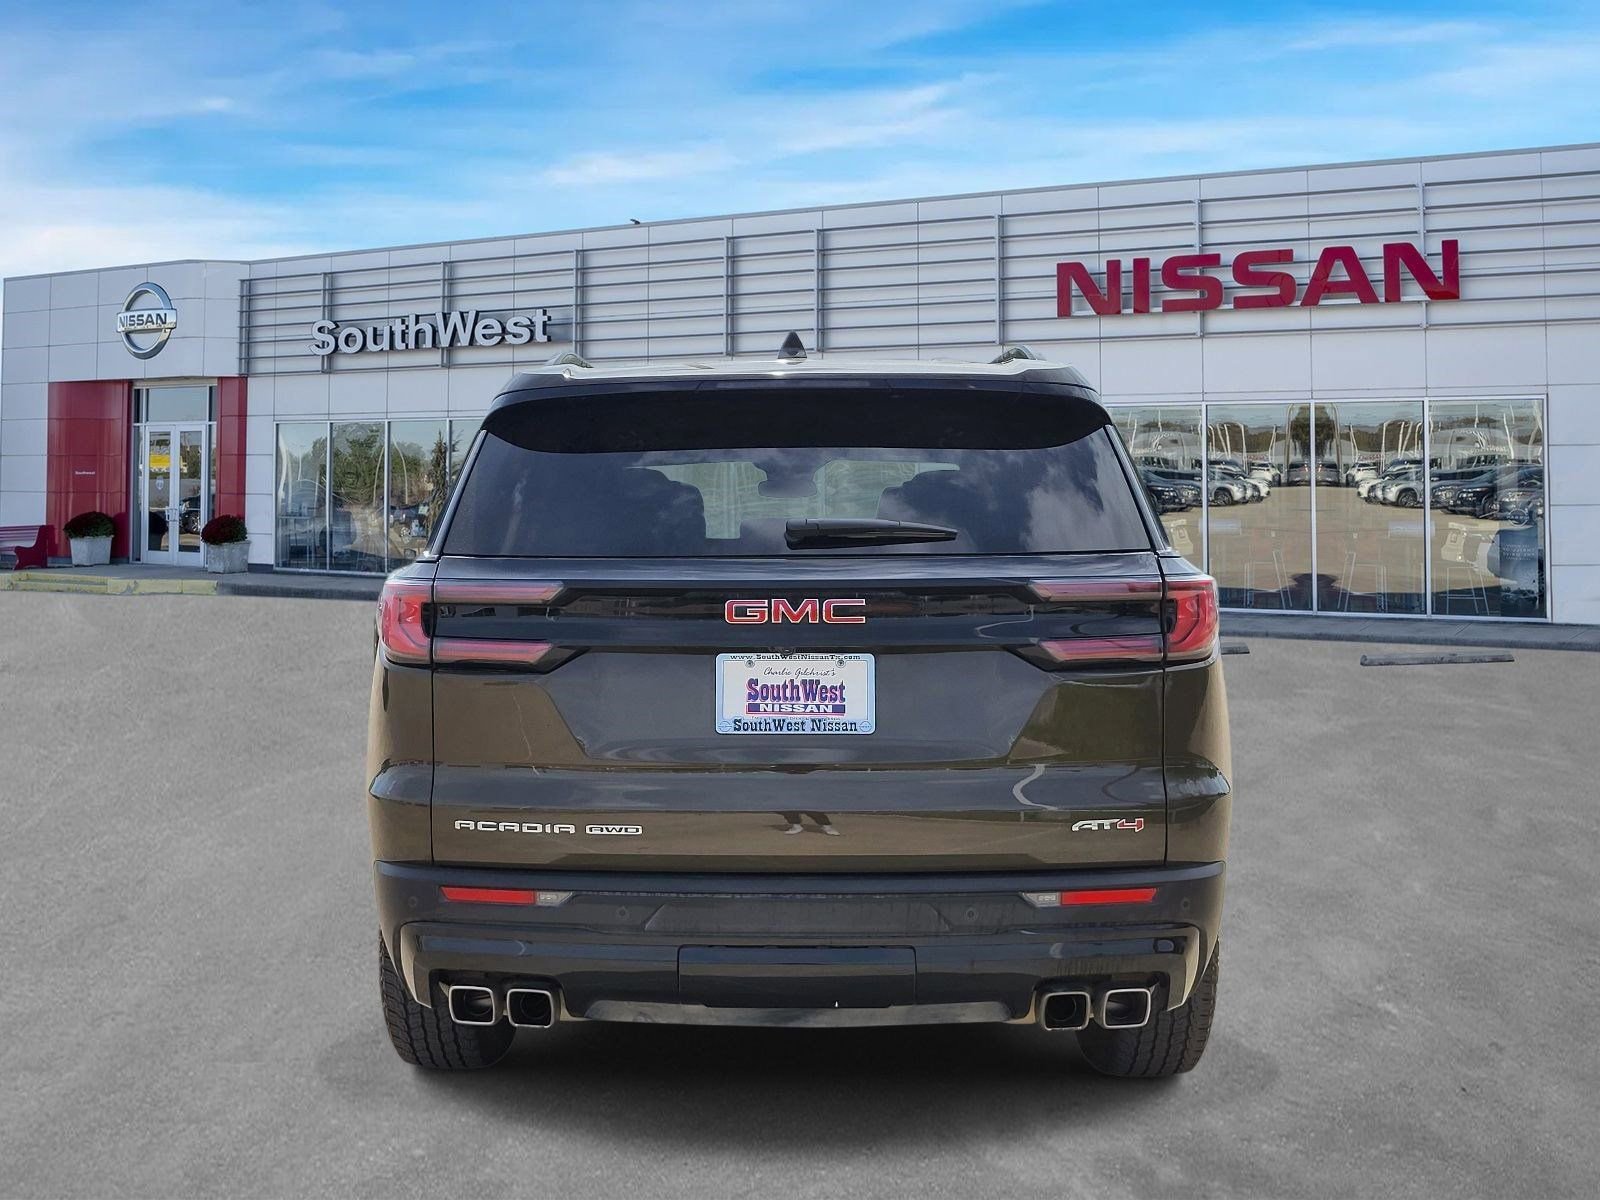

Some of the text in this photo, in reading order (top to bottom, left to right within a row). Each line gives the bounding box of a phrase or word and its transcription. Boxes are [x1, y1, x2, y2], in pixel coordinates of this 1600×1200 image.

[1056, 239, 1461, 318] NISSAN
[119, 312, 167, 329] NISSAN
[310, 308, 552, 356] SouthWest
[724, 598, 866, 624] GMC
[729, 653, 861, 661] www.SouthWestNissanTx.com
[763, 666, 836, 680] Charlie Gilchrist's
[747, 677, 846, 703] SouthWest
[759, 703, 833, 713] NISSAN
[733, 718, 806, 732] SouthWest
[811, 718, 858, 732] Nissan
[454, 819, 643, 835] ACADIA AWD
[1072, 818, 1145, 832] AT4
